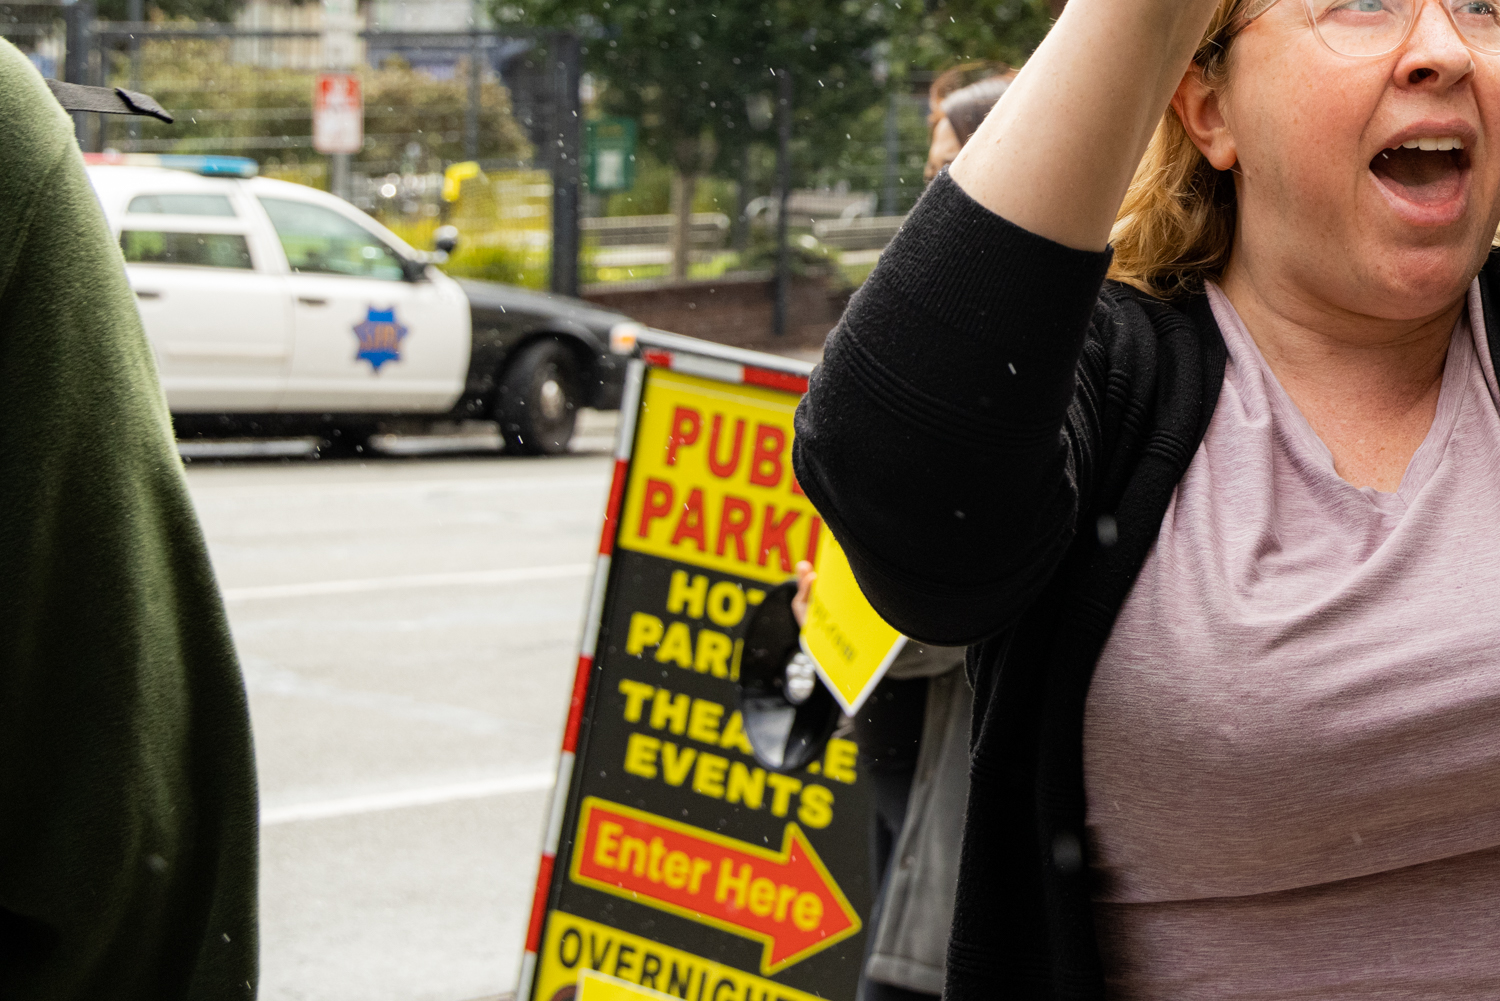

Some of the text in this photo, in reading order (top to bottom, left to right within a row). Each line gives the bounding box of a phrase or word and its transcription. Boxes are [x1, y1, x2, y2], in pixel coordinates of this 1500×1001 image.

[618, 678, 859, 785] THEAE
[623, 732, 835, 830] EVENTS
[593, 820, 824, 933] Enter Here
